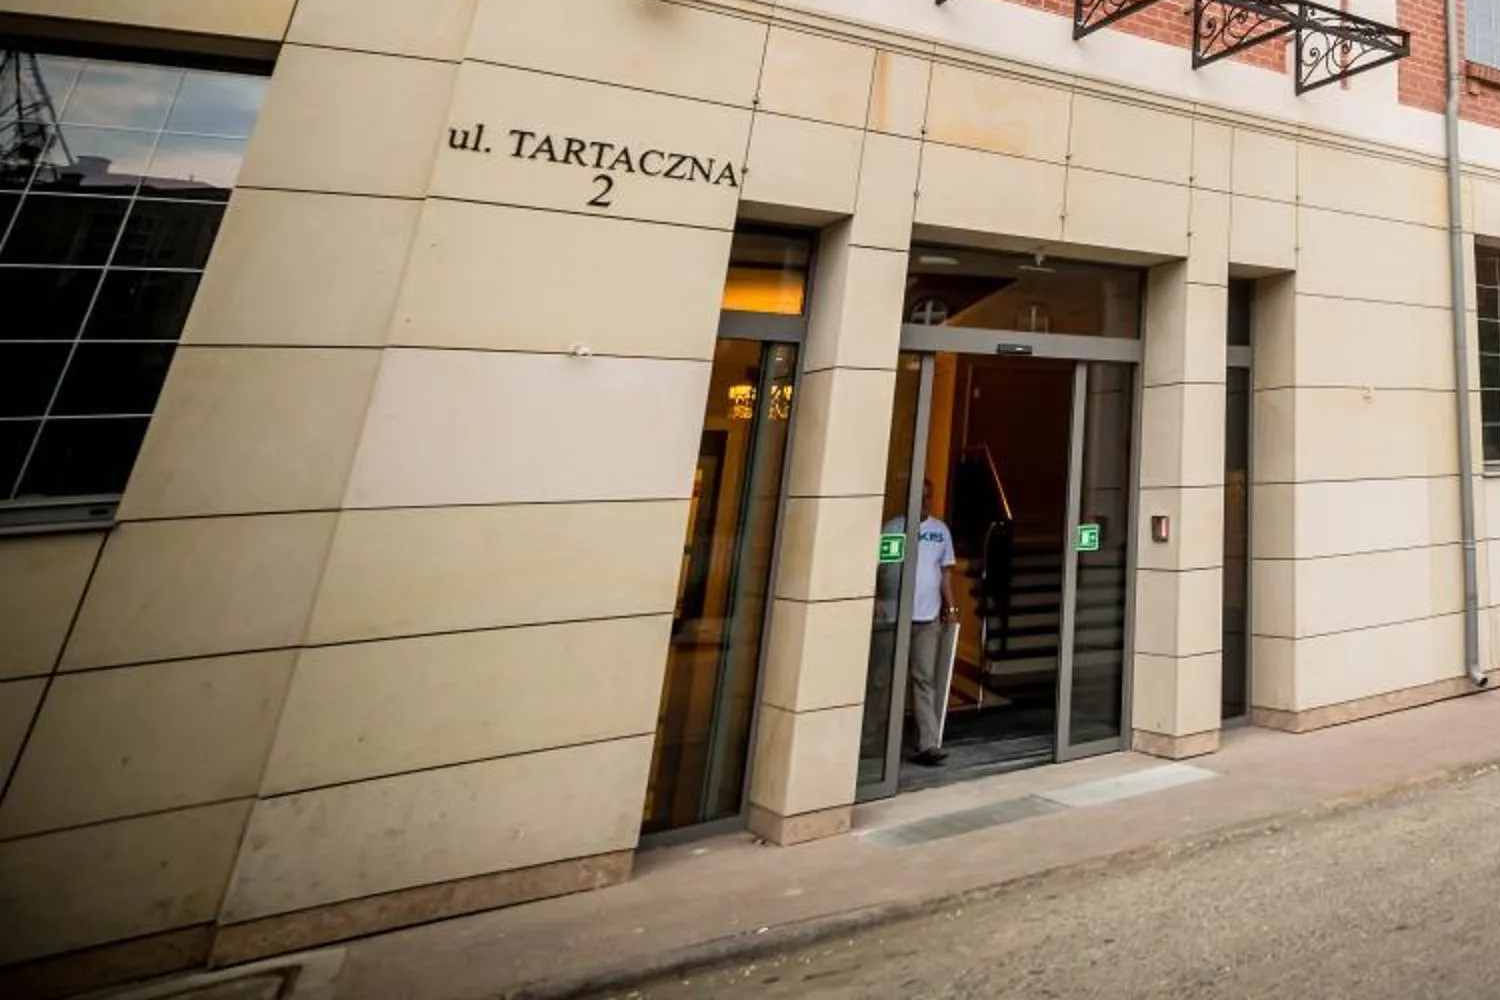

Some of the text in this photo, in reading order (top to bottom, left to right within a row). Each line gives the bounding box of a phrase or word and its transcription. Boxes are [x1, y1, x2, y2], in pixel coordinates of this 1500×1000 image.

[449, 124, 739, 187] ul. TARTACZNA
[587, 174, 614, 207] 2
